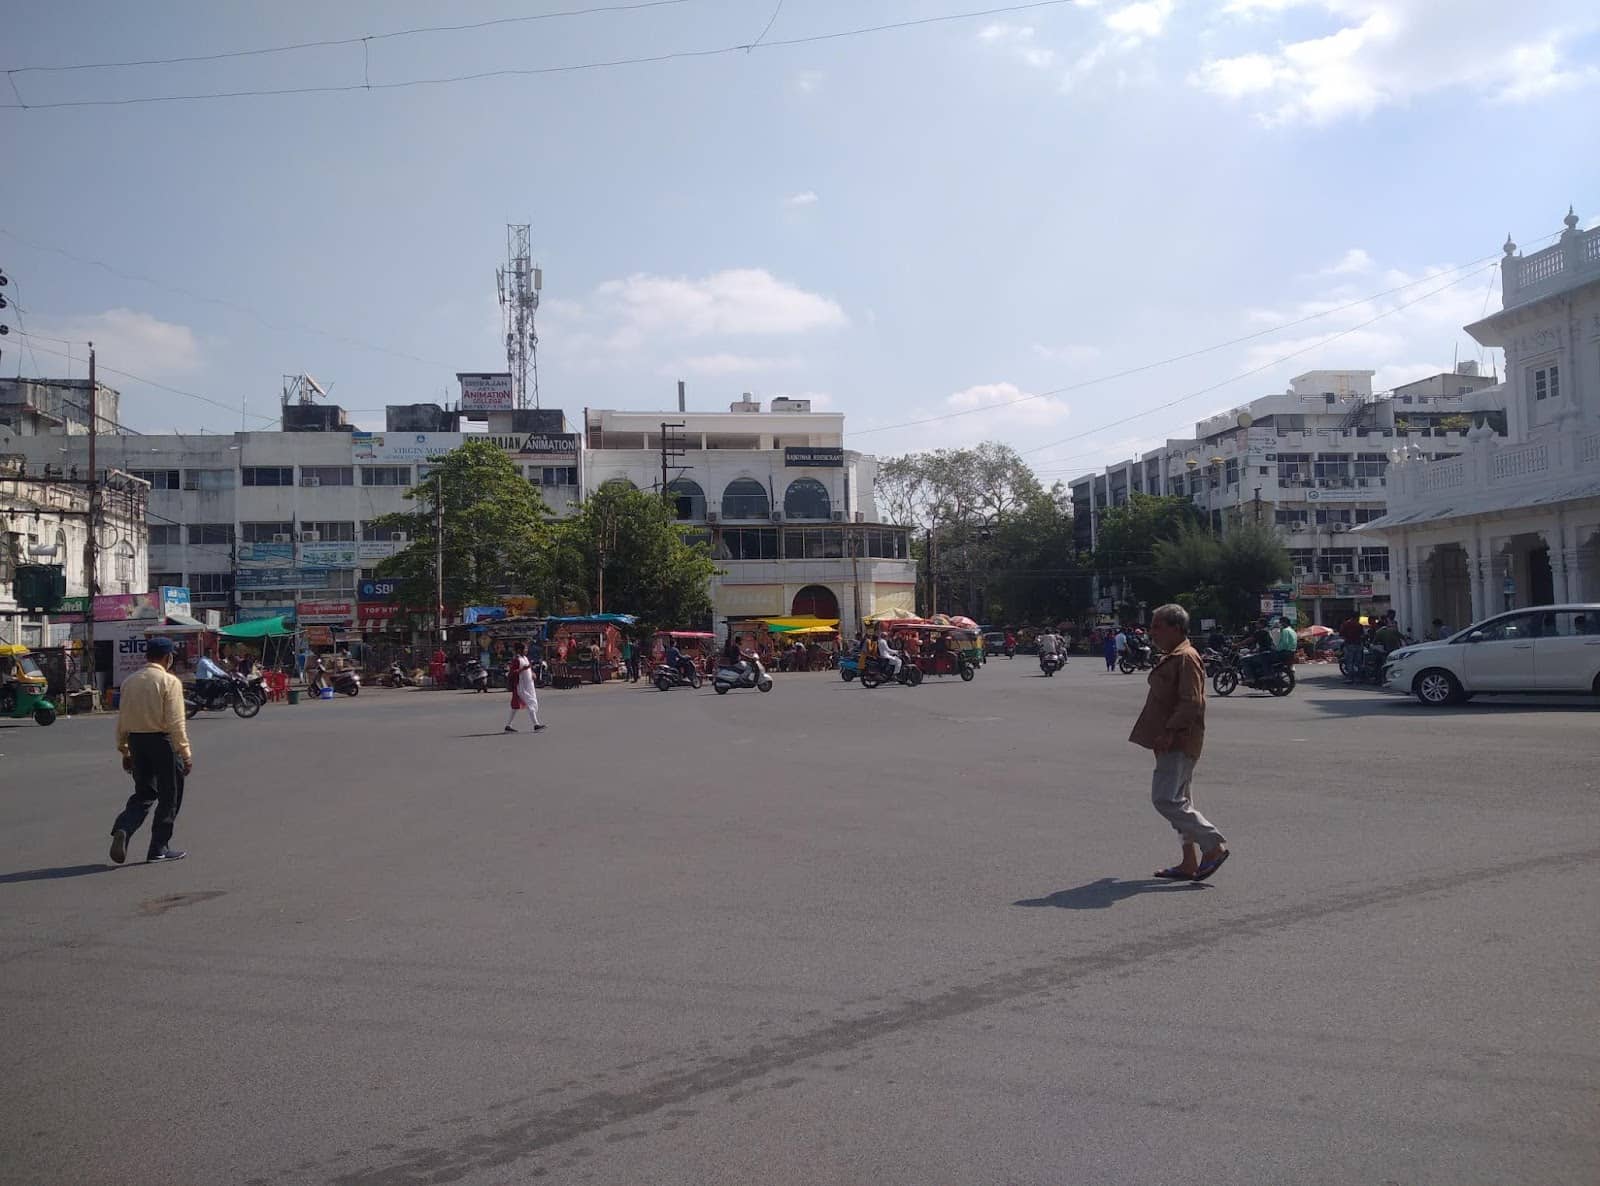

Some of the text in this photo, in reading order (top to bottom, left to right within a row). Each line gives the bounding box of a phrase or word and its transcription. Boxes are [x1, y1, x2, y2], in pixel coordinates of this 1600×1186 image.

[463, 390, 511, 399] ANIMATION
[526, 440, 575, 450] ANIMATION
[375, 583, 394, 594] SBI
